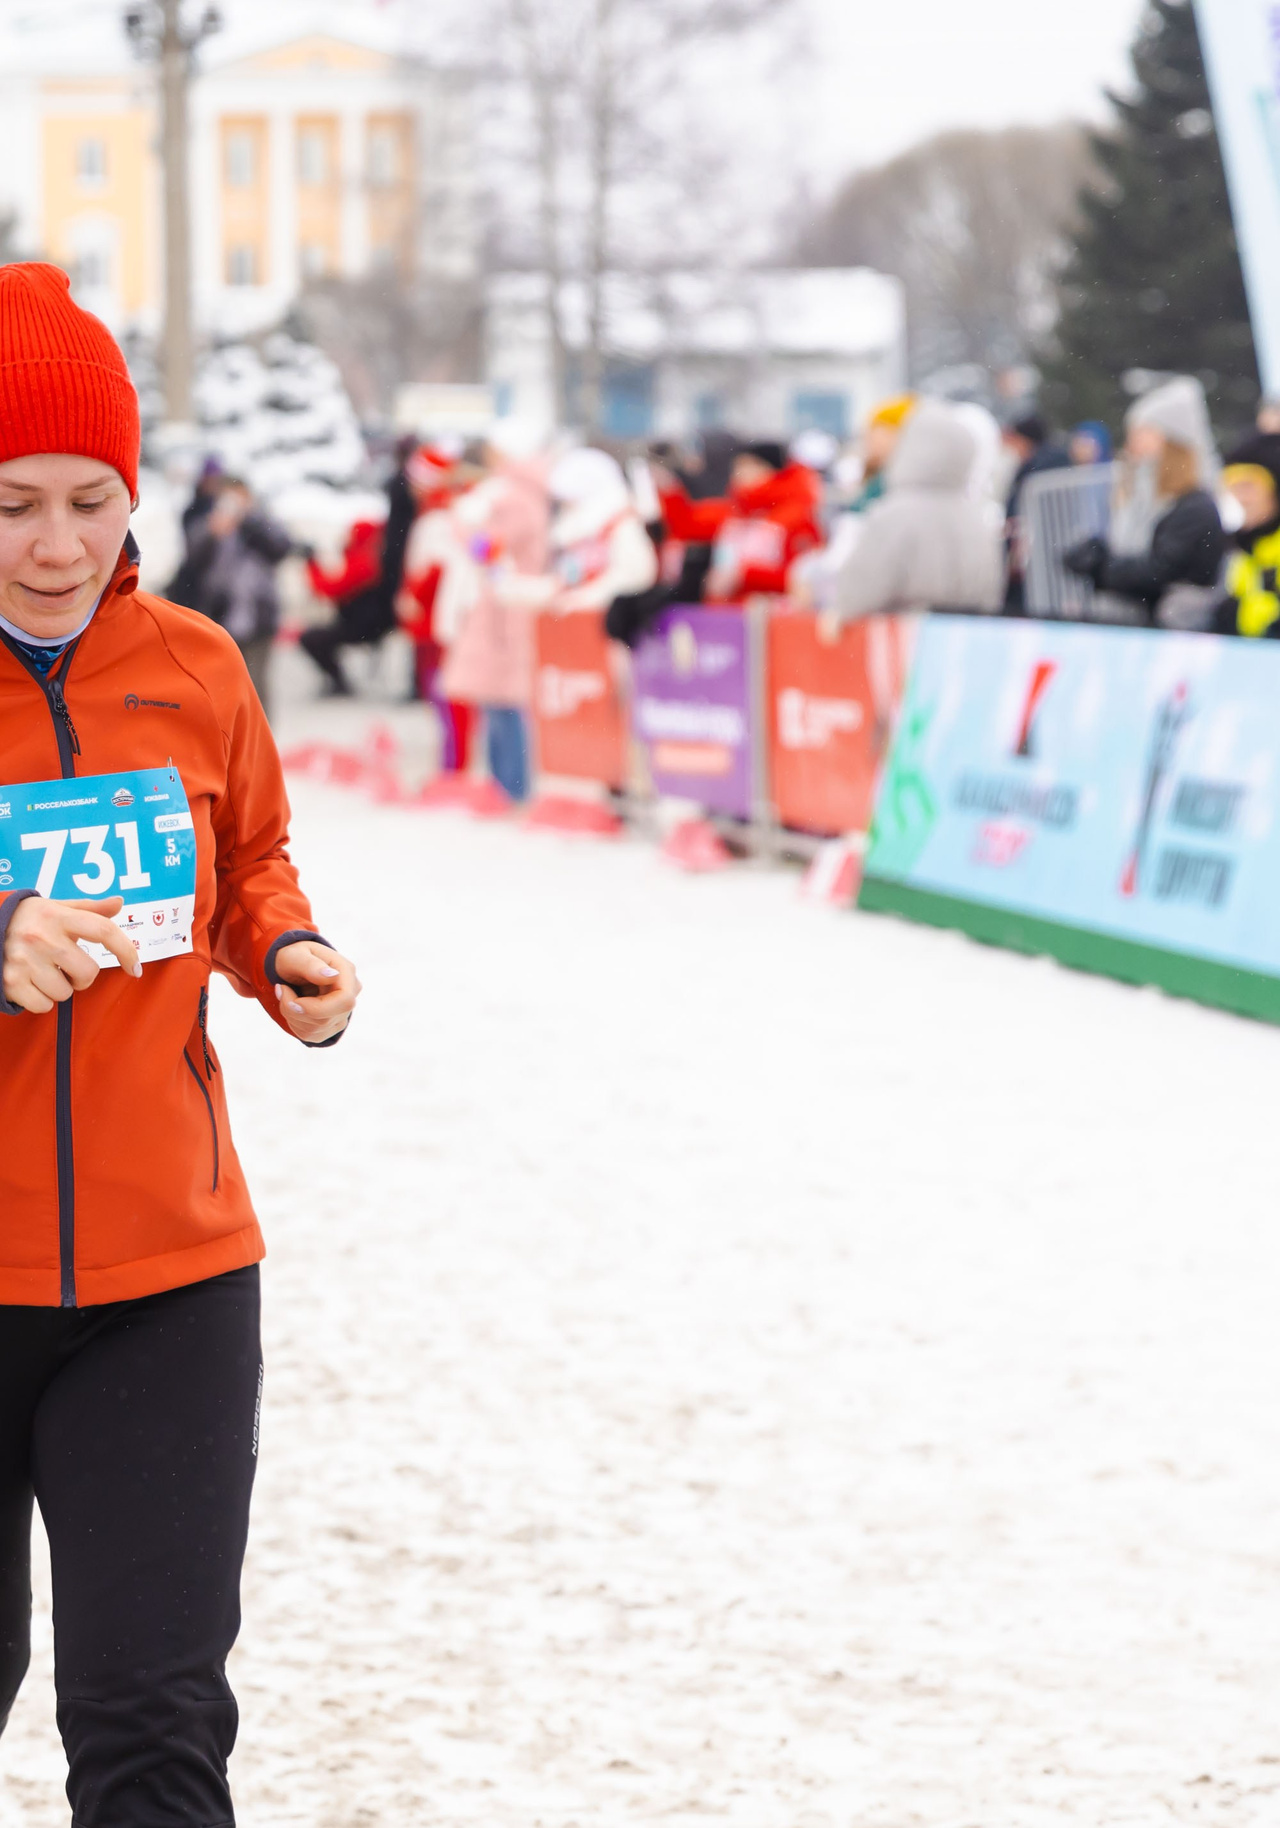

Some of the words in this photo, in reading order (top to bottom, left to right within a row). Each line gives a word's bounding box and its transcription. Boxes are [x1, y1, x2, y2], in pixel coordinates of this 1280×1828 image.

[34, 797, 98, 809] РОССЕЛЬХОЗБАНК
[166, 838, 176, 854] 5
[20, 821, 151, 899] 731
[164, 854, 181, 867] КМ
[252, 1363, 264, 1456] NORDSKI
